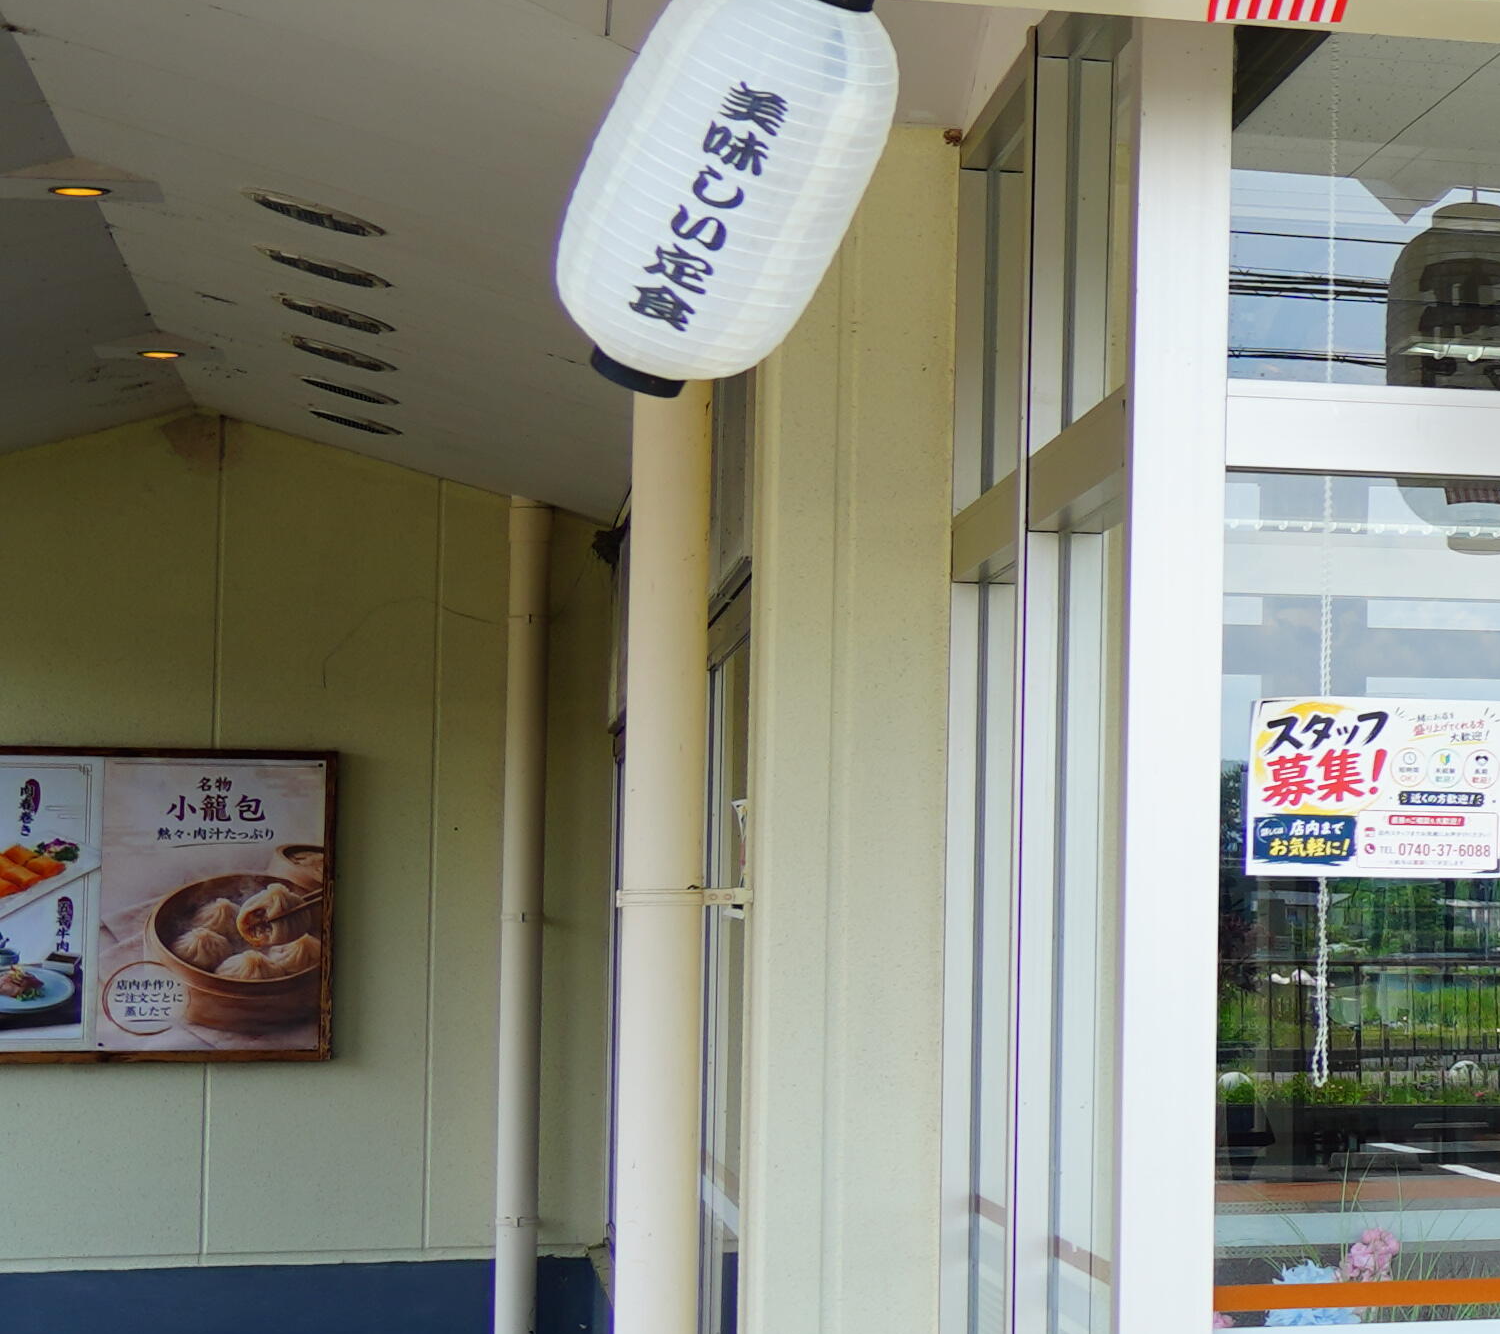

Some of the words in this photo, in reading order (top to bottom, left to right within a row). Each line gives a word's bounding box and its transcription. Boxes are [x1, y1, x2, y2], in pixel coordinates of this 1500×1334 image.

[628, 80, 788, 332] 美味しい定食
[1263, 710, 1390, 755] スタッフ
[196, 776, 233, 792] 名物
[1262, 748, 1388, 807] 募集!
[166, 793, 266, 822] 小籠包
[1288, 819, 1345, 836] 店内まで
[1269, 837, 1351, 857] お気軽に!
[114, 992, 183, 1004] ご注文ごとに
